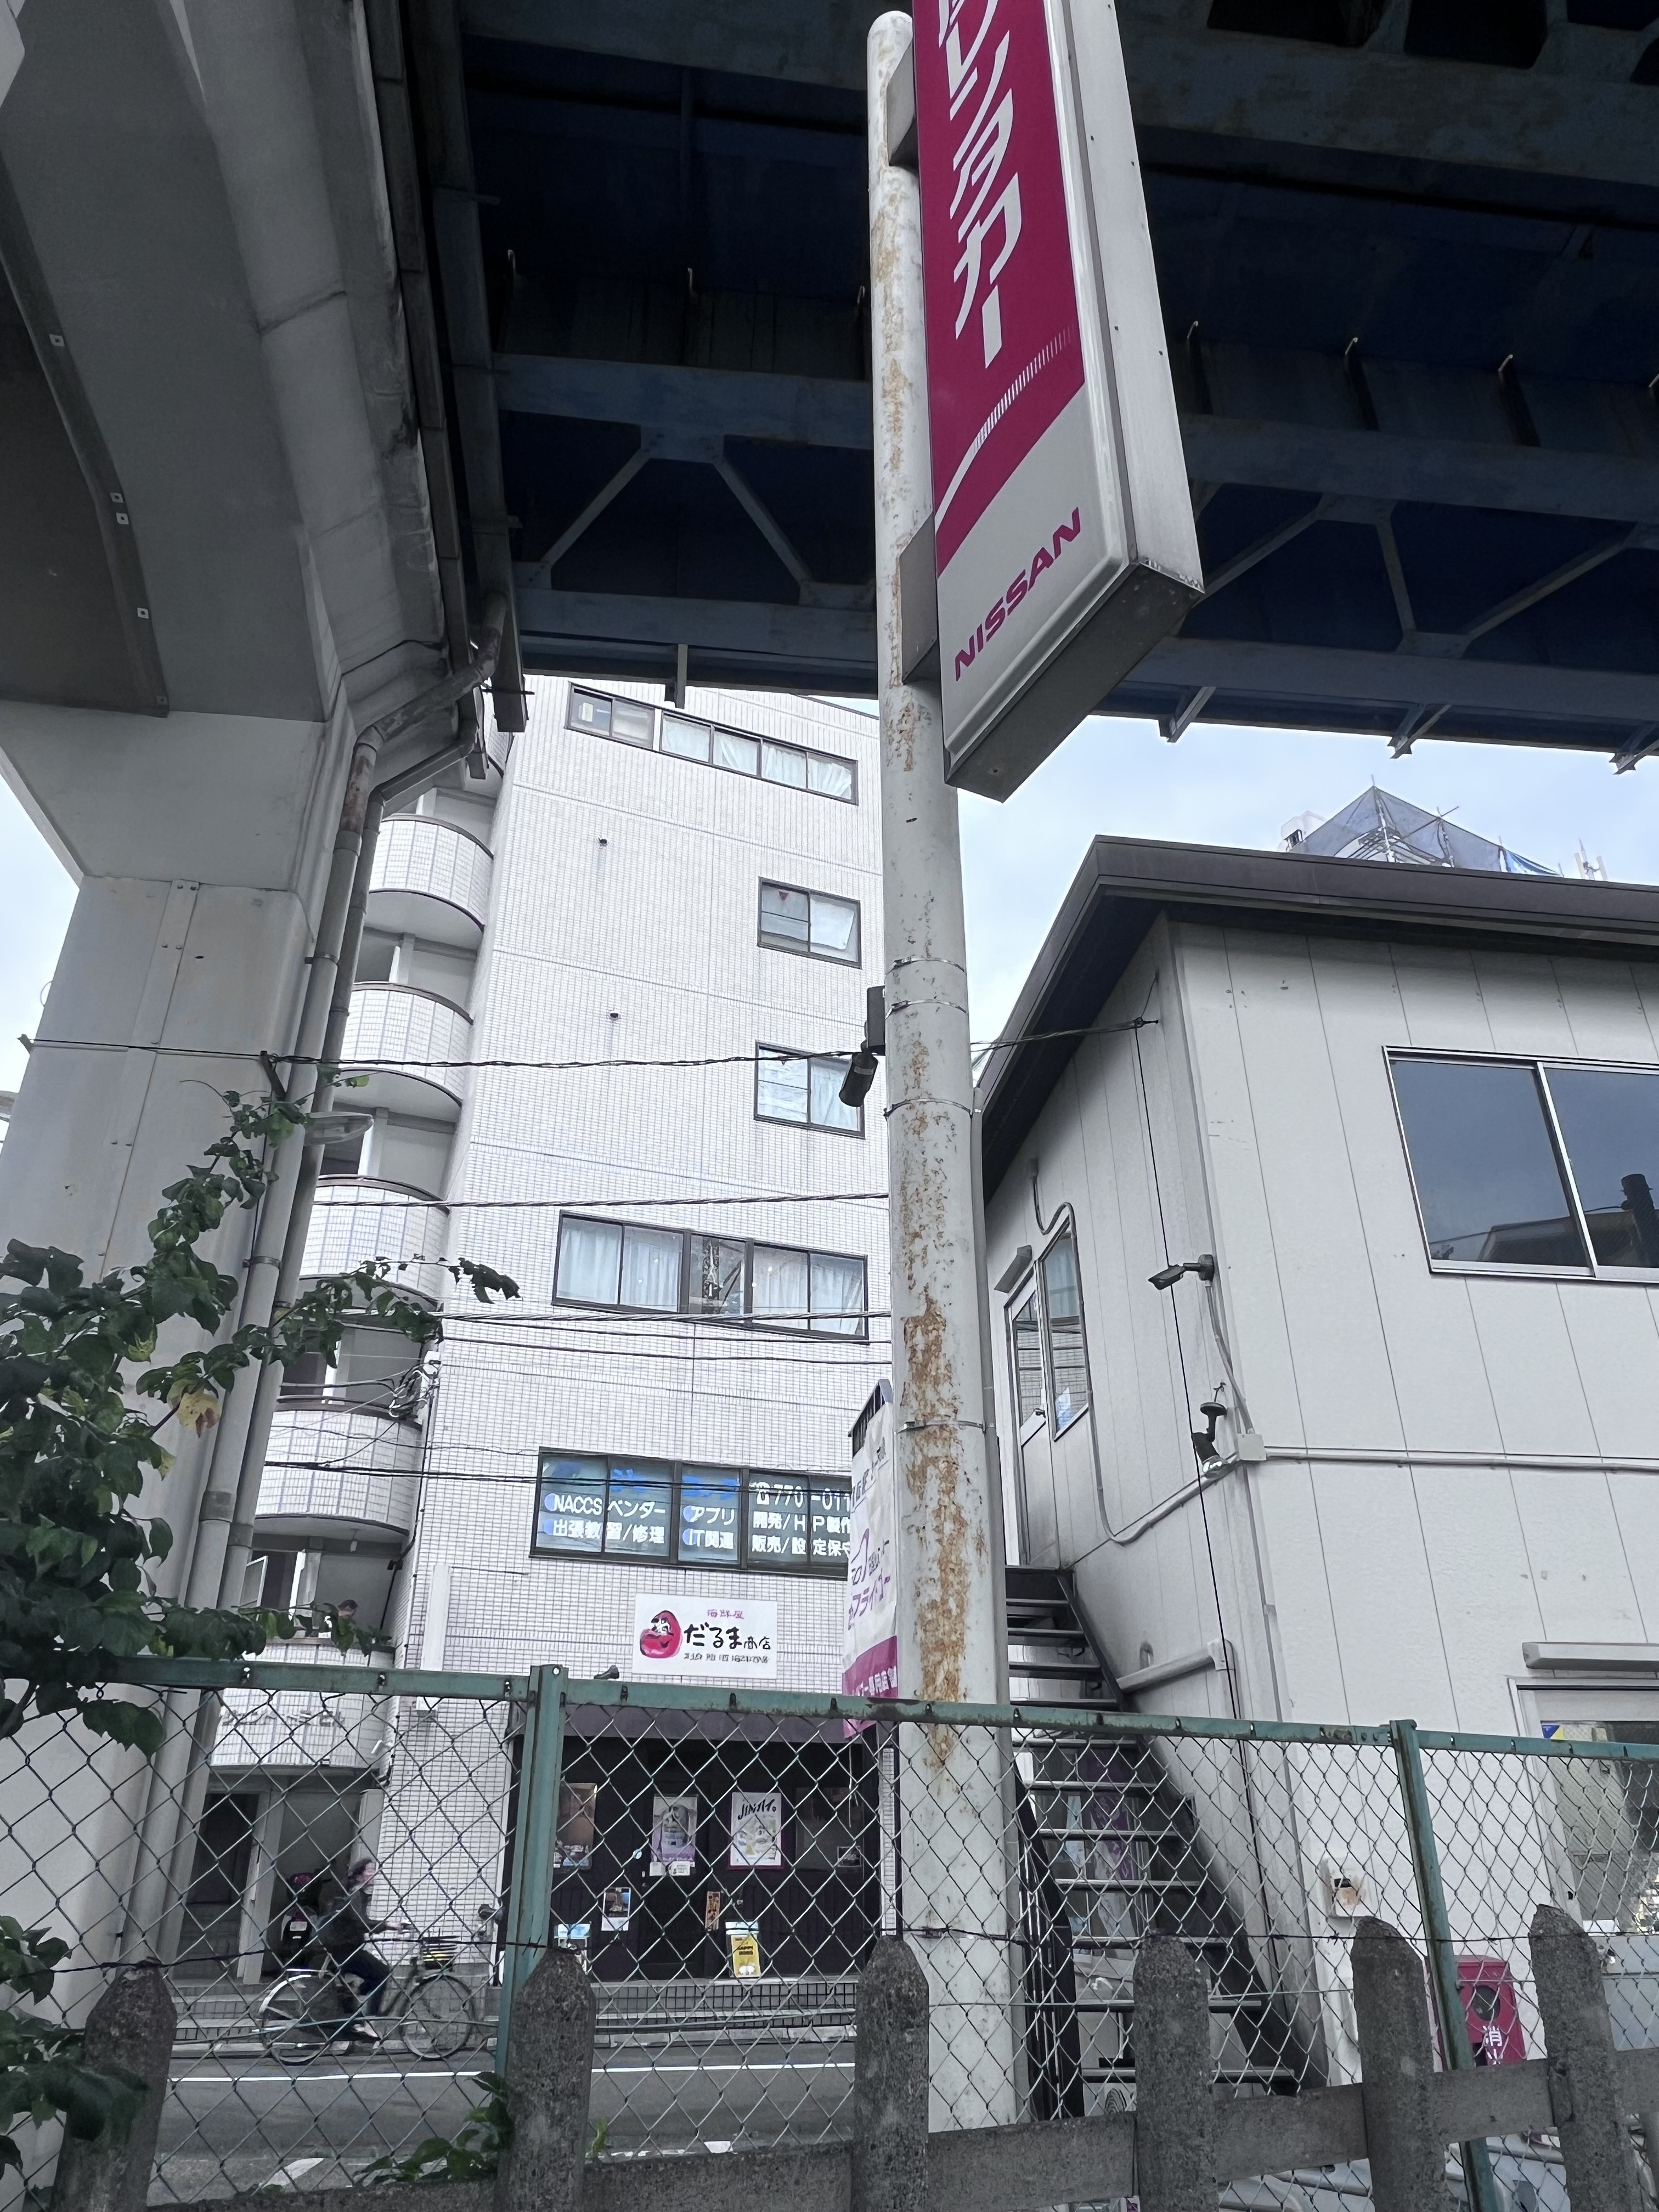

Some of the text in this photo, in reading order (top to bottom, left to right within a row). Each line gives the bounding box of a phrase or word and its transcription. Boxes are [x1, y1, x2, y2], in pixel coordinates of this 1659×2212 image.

[938, 0, 1022, 369] レンタカー
[955, 507, 1081, 682] NISSAN
[684, 1622, 771, 1649] だるま商店
